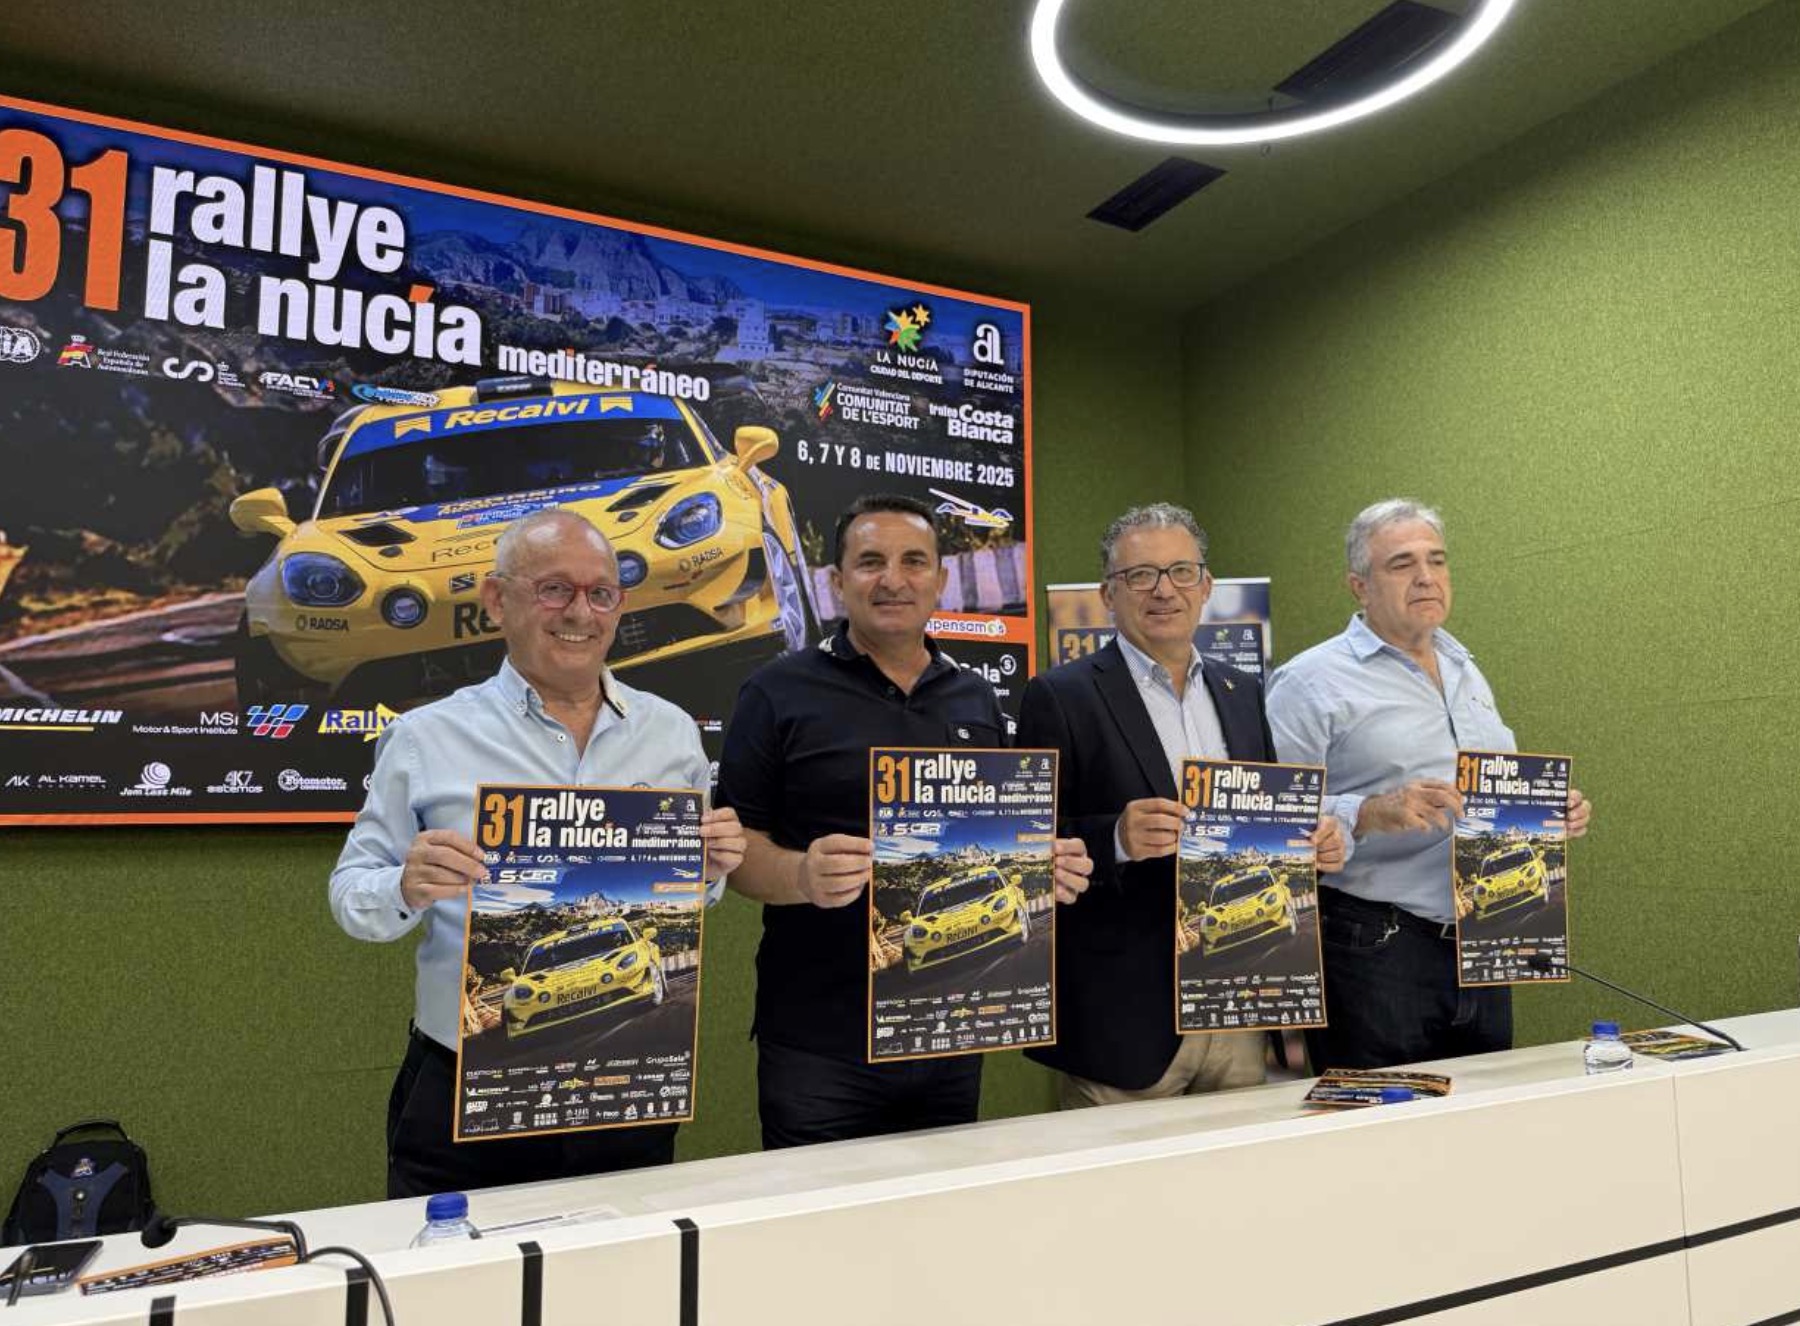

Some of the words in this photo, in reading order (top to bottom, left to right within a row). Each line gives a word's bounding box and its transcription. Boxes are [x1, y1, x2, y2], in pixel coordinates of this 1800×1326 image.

[0, 129, 128, 311] 31
[150, 165, 404, 280] rallye
[144, 239, 227, 329] la
[257, 284, 482, 366] nucía
[876, 351, 891, 363] LA
[498, 344, 710, 401] mediterráneo
[963, 368, 1014, 384] DIPUTACIÓN
[964, 379, 977, 388] DE
[978, 381, 1014, 393] ALICANTE
[443, 400, 591, 429] Recalvi
[836, 393, 911, 415] COMUNITAT
[959, 404, 1014, 429] Costa
[842, 407, 860, 421] DE
[862, 411, 920, 430] L'ESPORT
[947, 419, 1014, 445] Blanca
[797, 440, 814, 465] 6,
[819, 443, 830, 464] 7
[833, 446, 846, 465] Y
[849, 447, 861, 468] 8
[866, 455, 881, 471] DE
[885, 452, 973, 482] NOVIEMBRE
[976, 464, 1015, 488] 2025
[308, 617, 350, 631] RADSA
[878, 755, 910, 803] 31
[915, 754, 976, 784] rallye
[1214, 766, 1261, 793] rallye
[1458, 756, 1479, 794] 31
[1481, 756, 1518, 779] rallye
[915, 780, 934, 803] la
[1185, 765, 1211, 807] 31
[1480, 774, 1492, 793] la
[529, 792, 605, 827] rallye
[1213, 788, 1227, 809] la
[483, 793, 525, 848] 31
[528, 821, 551, 847] la
[560, 821, 627, 847] nucía
